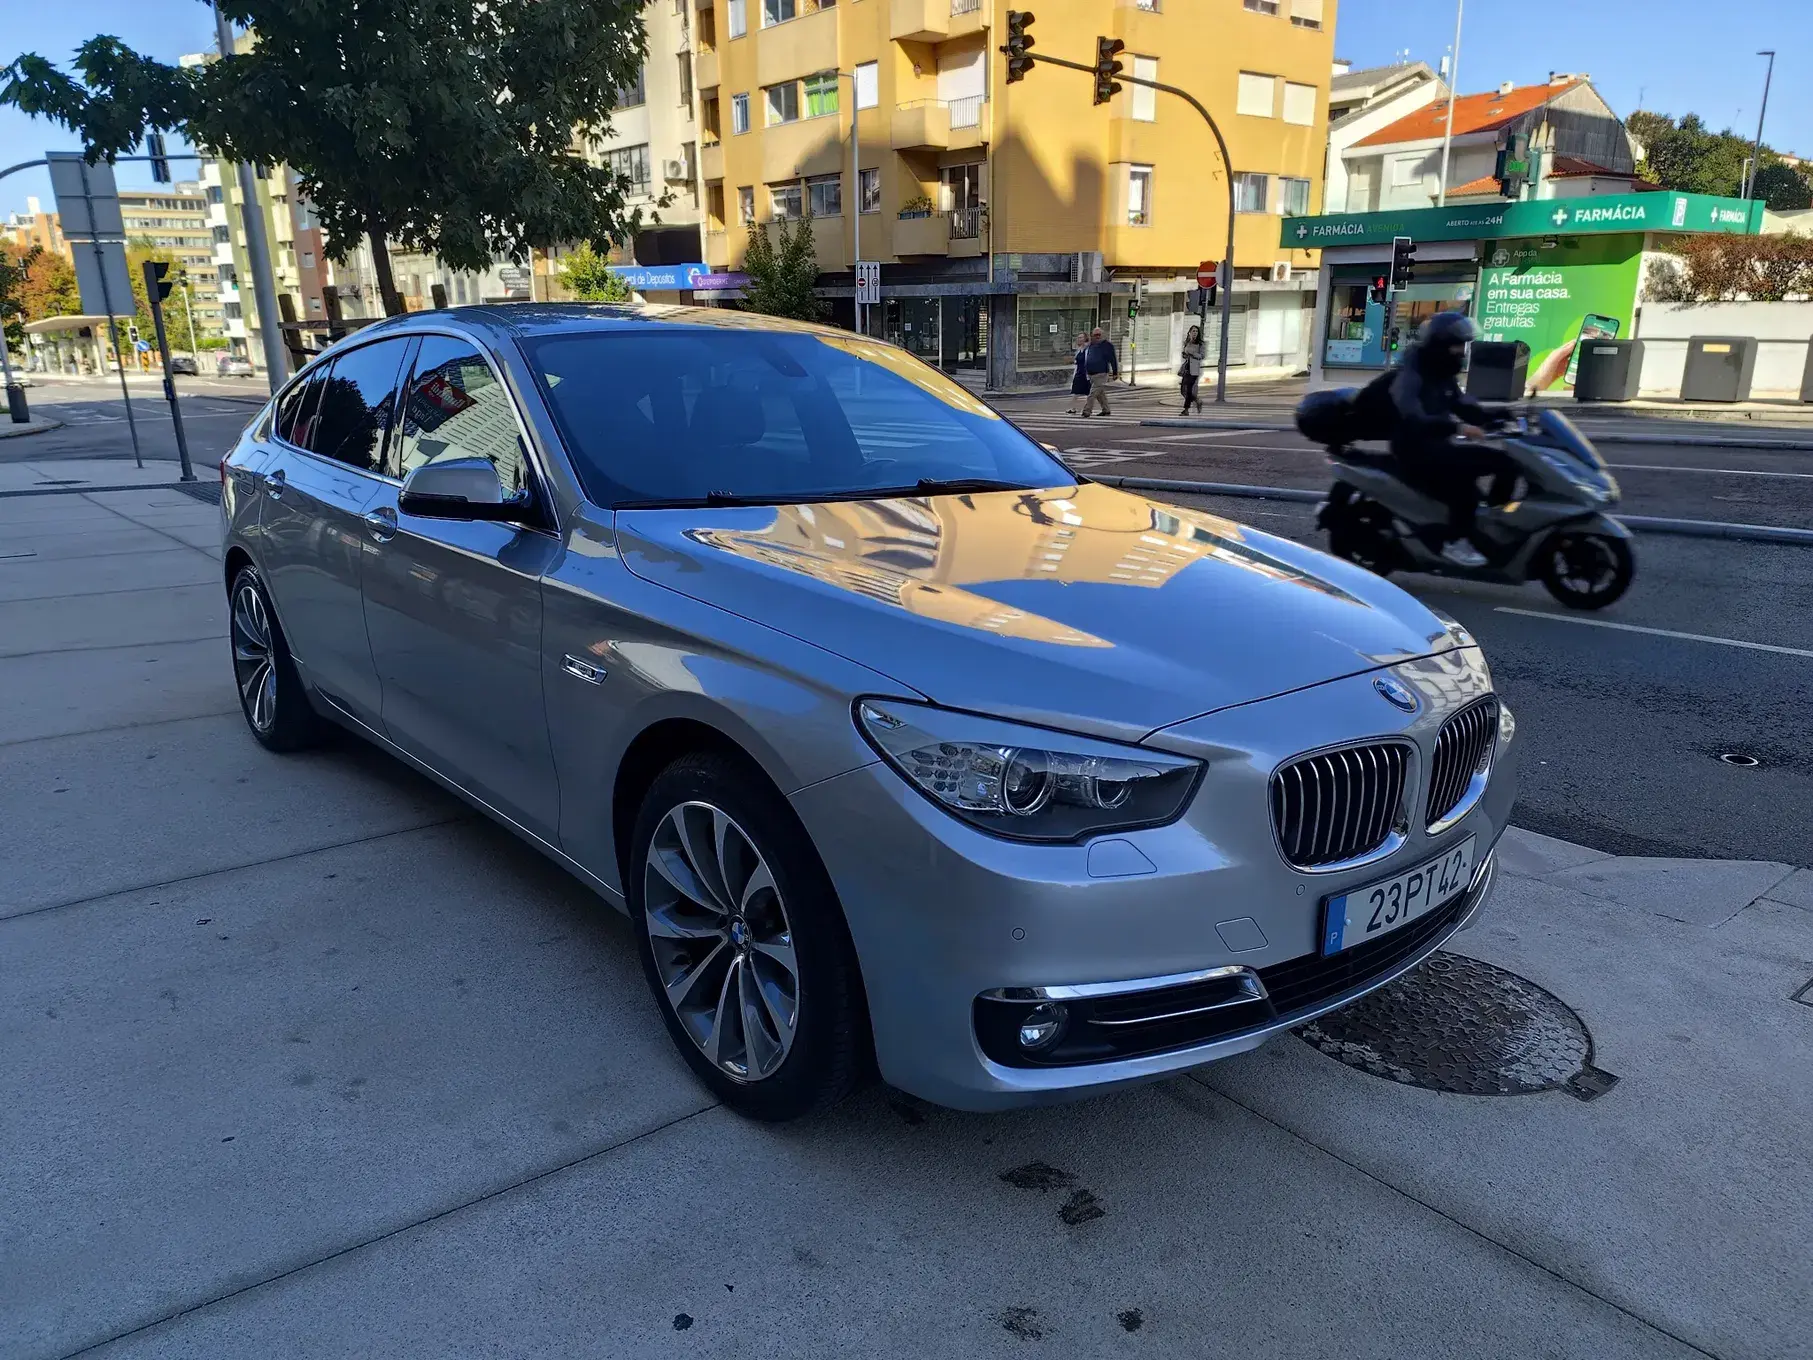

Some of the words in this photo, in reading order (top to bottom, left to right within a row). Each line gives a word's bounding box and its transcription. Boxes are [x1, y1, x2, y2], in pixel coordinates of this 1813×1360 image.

[1485, 216, 1503, 224] 24H
[1575, 204, 1645, 222] FARMÁCIA
[1719, 208, 1746, 224] FARMÁCIA
[1312, 221, 1364, 236] FARMÁCIA
[1367, 223, 1405, 234] AVENIDA
[638, 273, 645, 284] de
[1488, 273, 1499, 285] A
[1502, 271, 1562, 285] Farmácia
[1487, 289, 1507, 299] em
[1510, 288, 1533, 299] sua
[1536, 288, 1571, 299] casa.
[1486, 301, 1540, 316] Entregas
[1484, 314, 1536, 329] gratuitas.
[1330, 932, 1337, 944] P
